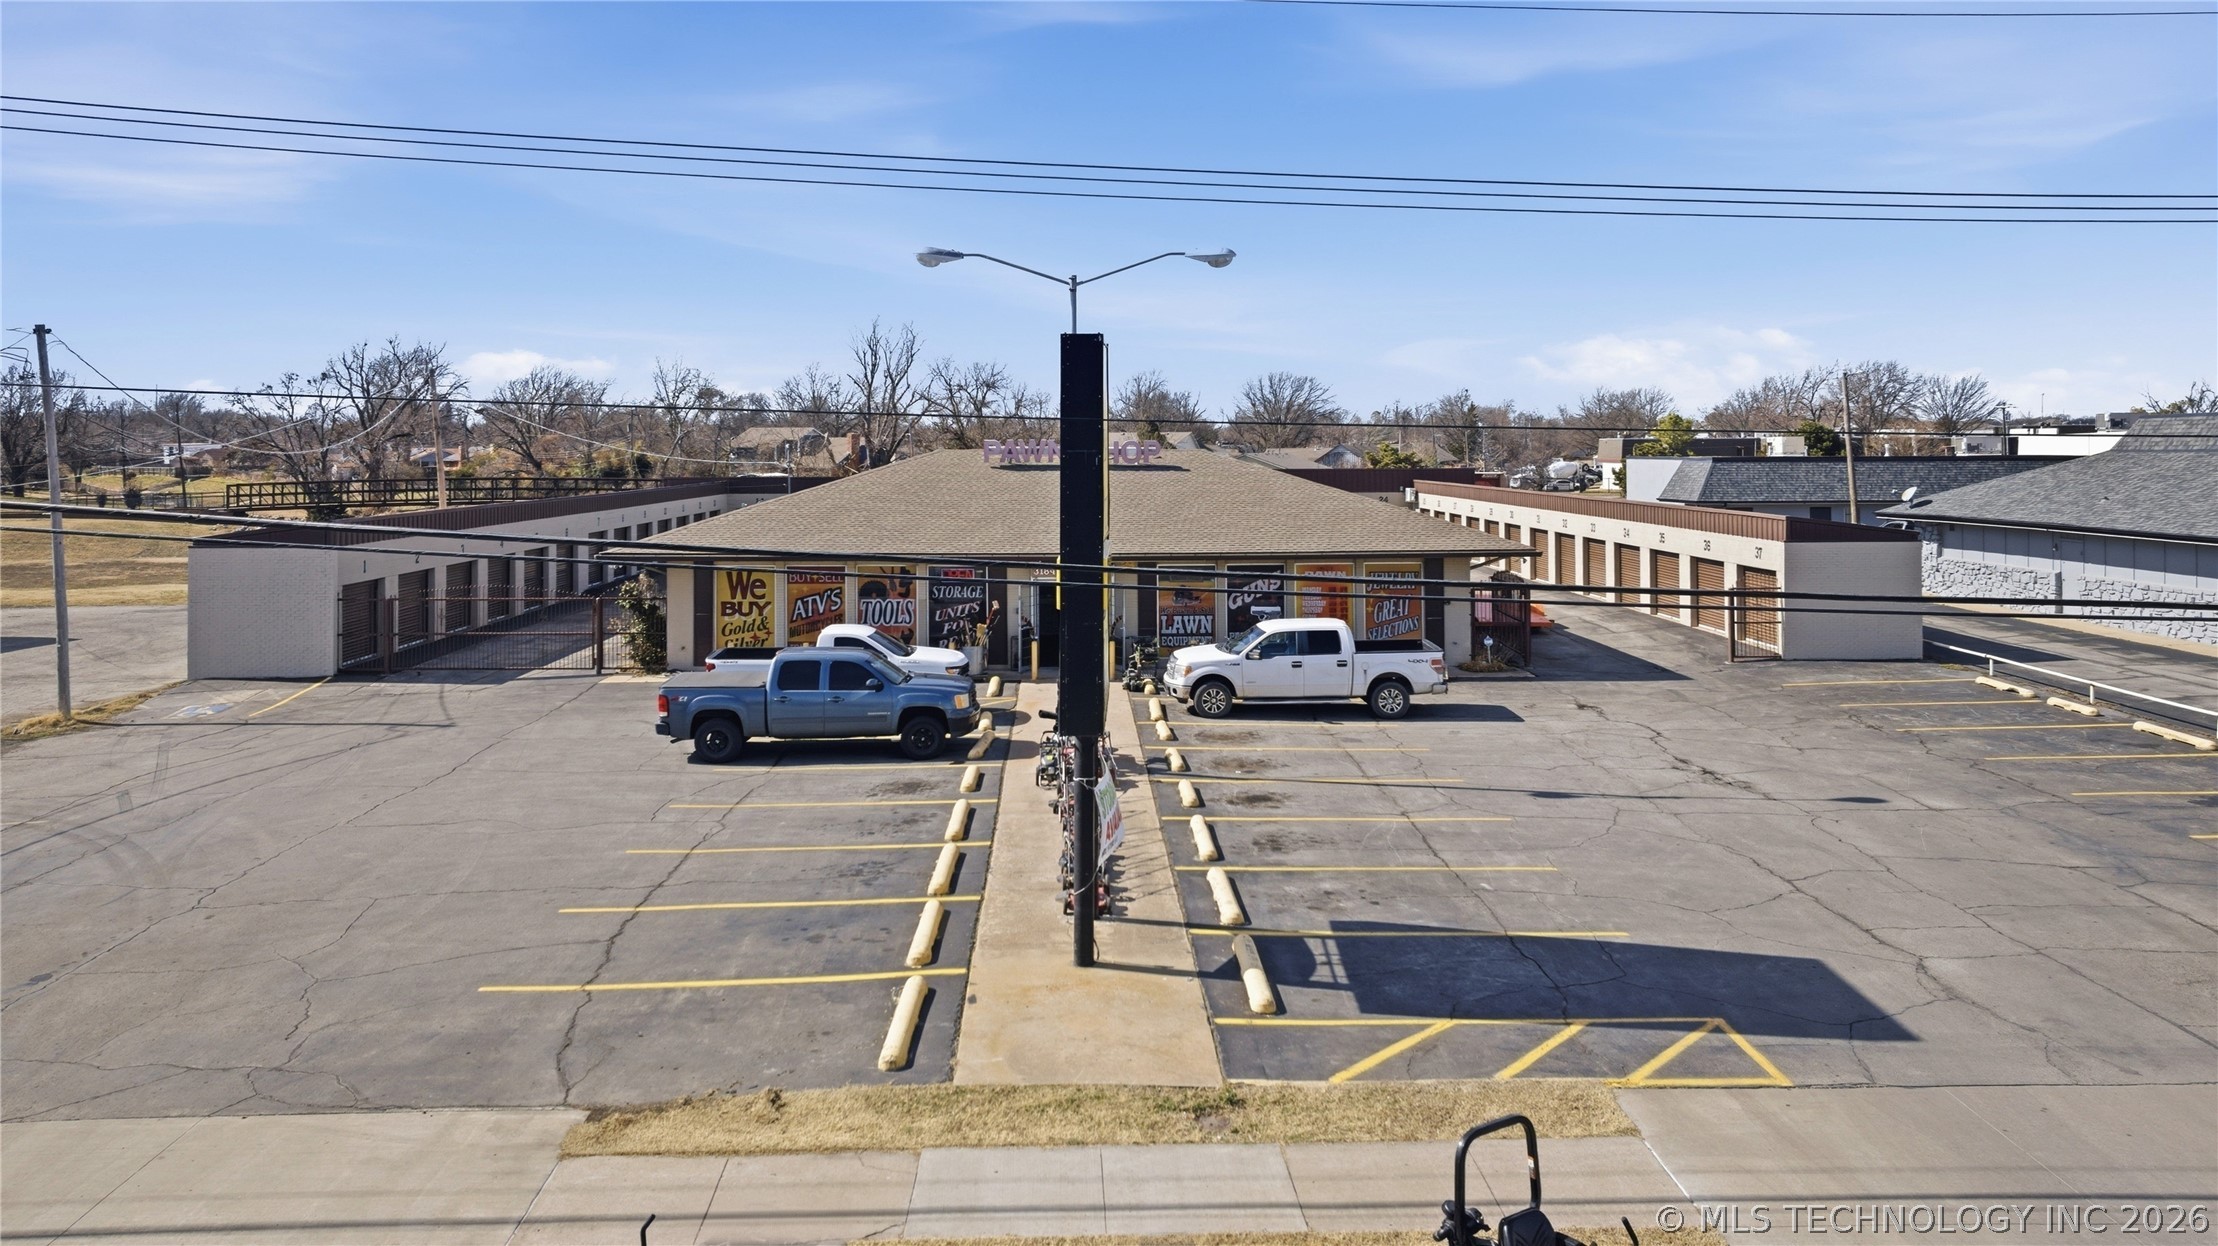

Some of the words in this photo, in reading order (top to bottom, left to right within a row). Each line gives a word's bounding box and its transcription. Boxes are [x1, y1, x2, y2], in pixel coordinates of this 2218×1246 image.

[1703, 540, 1711, 551] 36
[1755, 547, 1763, 559] 37
[726, 571, 767, 600] We
[932, 585, 984, 598] STORAGE
[721, 601, 772, 617] BUY
[791, 588, 841, 621] ATV'S
[861, 599, 914, 626] TOOLS
[935, 601, 981, 621] UNITS
[722, 619, 756, 637] Gold
[757, 616, 770, 632] &
[1161, 615, 1213, 634] LAWN
[1368, 616, 1419, 641] SELECTIONS
